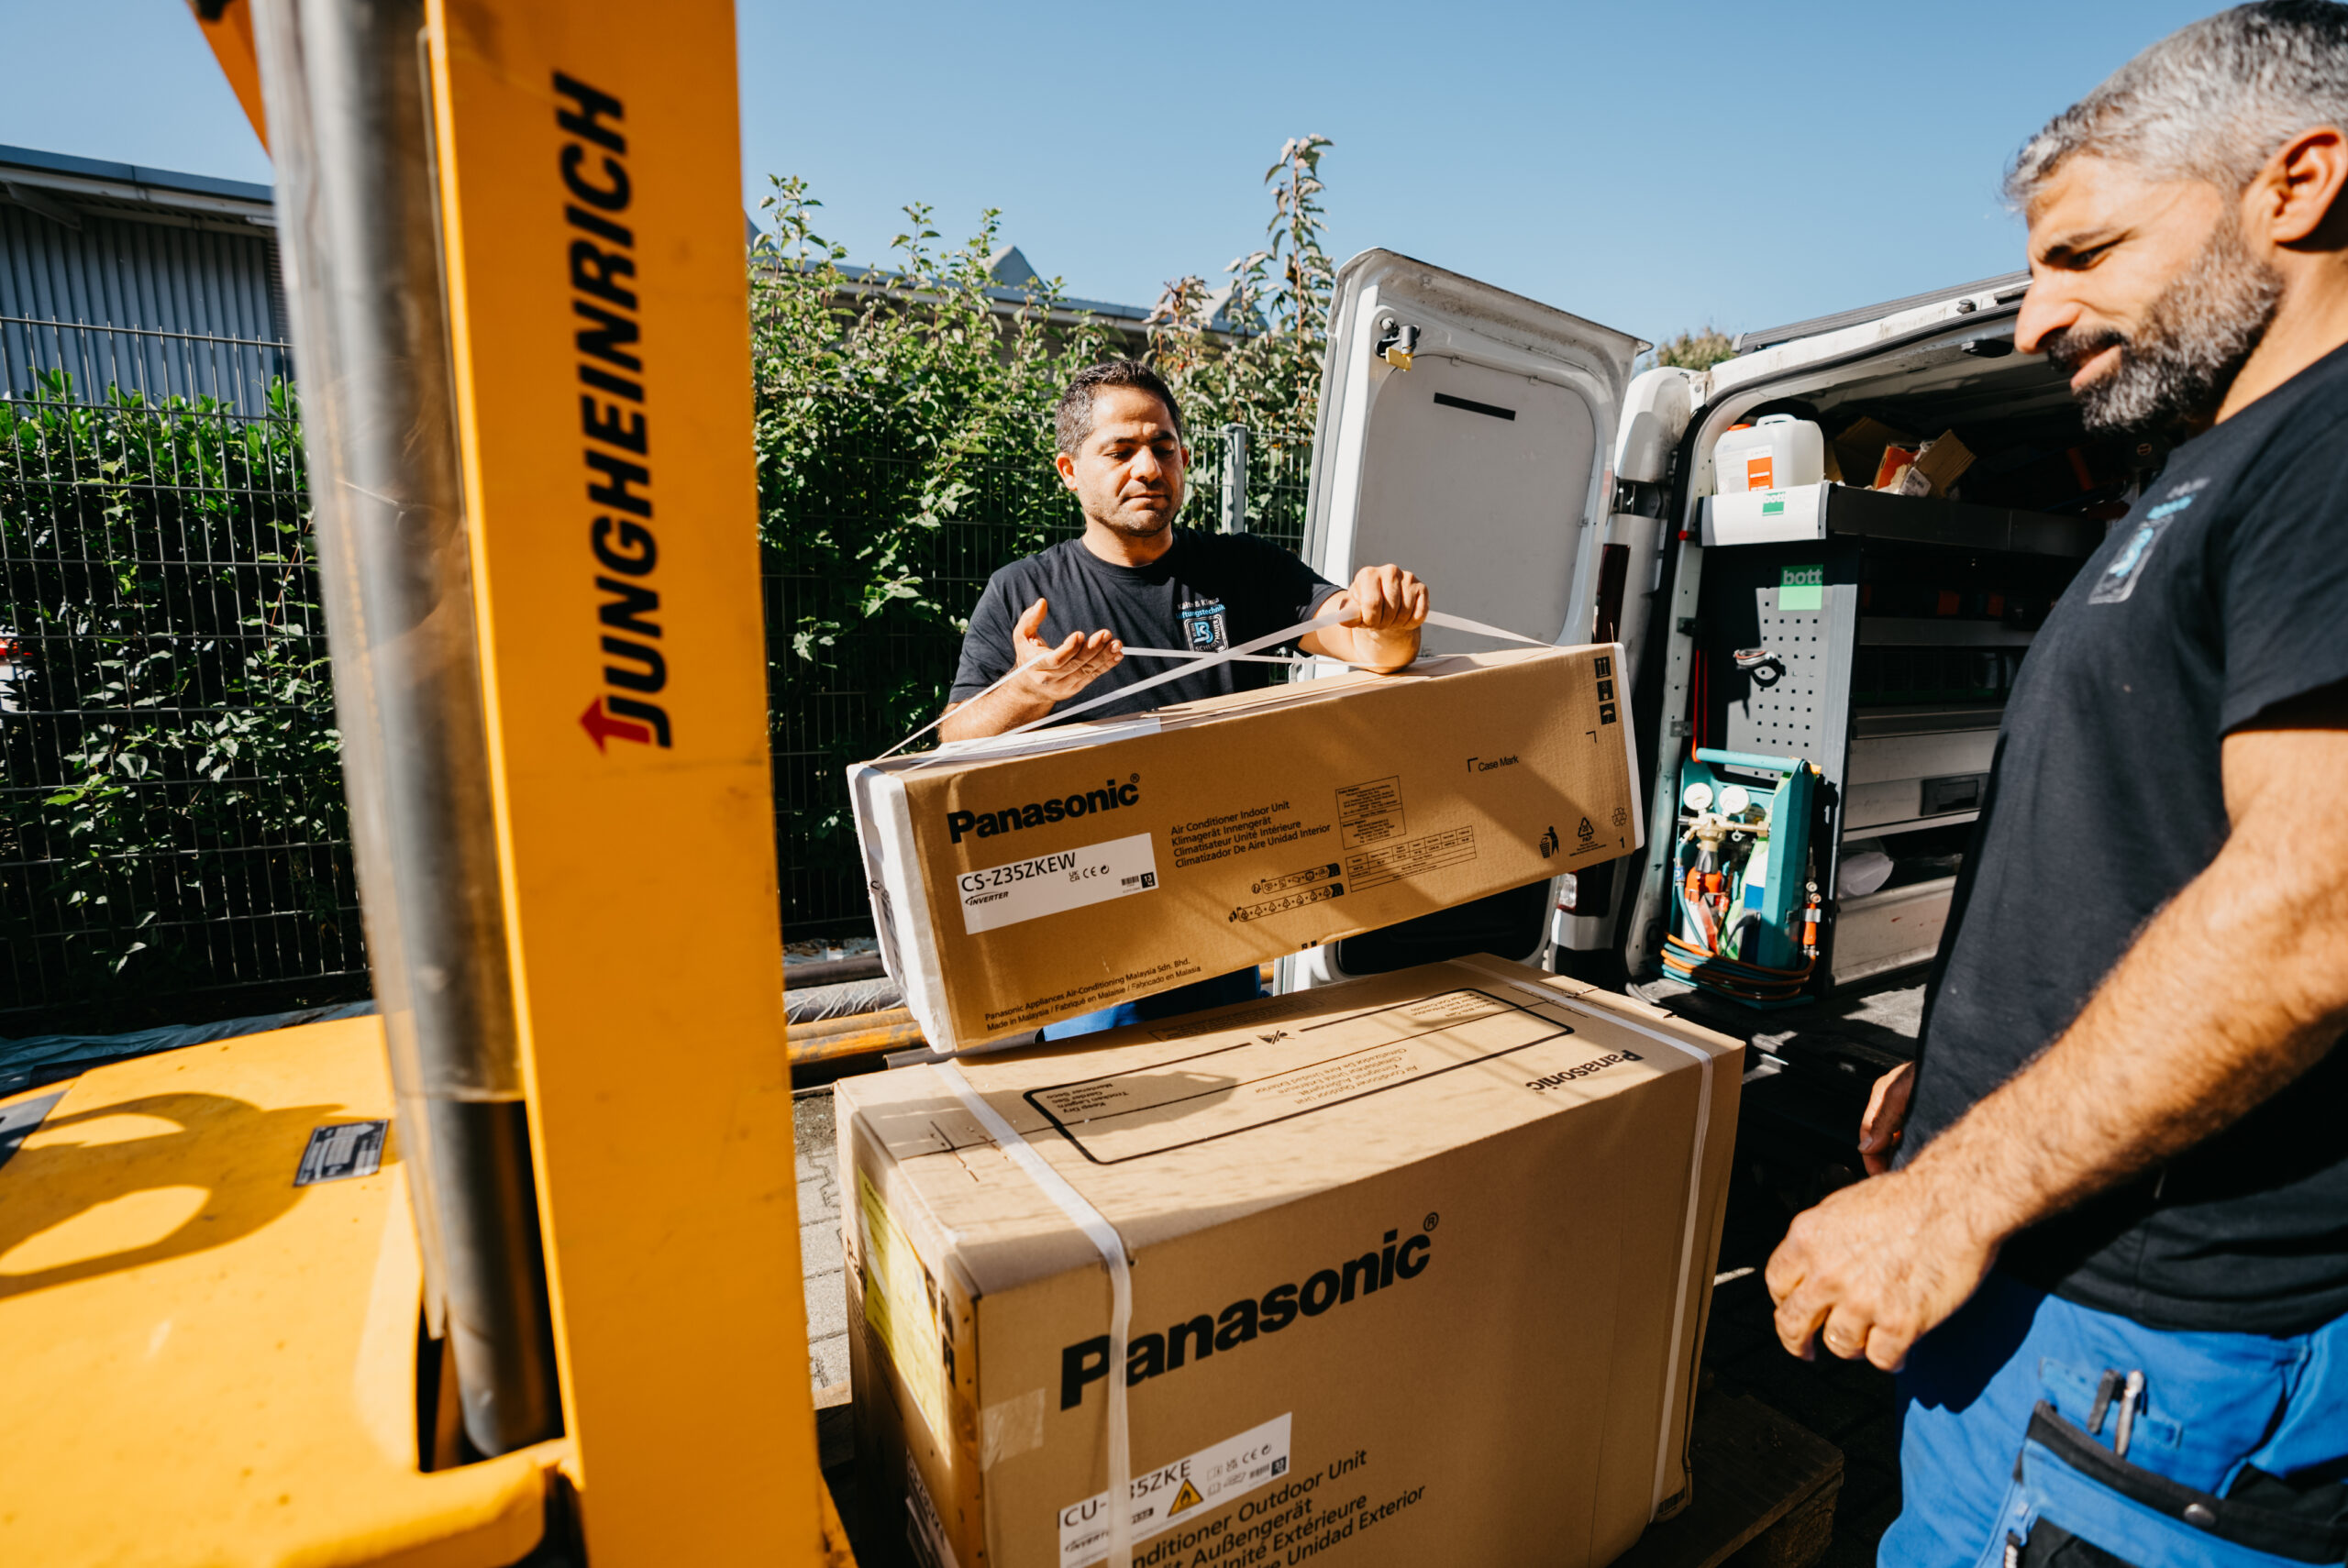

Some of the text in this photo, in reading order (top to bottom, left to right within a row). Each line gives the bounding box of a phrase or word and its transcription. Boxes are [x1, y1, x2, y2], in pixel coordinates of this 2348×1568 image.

[552, 70, 672, 749] JUNGHEINRICH
[1764, 491, 1787, 503] bott
[1783, 569, 1822, 585] bott
[1478, 755, 1519, 772] Case Mark
[947, 778, 1140, 845] Panasonic
[1170, 800, 1290, 835] Air Conditioner Indoor Unit
[1171, 816, 1271, 846] Klimagerät Innengerät
[1173, 821, 1301, 857] Climatisateur Unité Intérieure
[1175, 848, 1232, 868] Climatizador
[1233, 845, 1246, 855] De
[1247, 840, 1266, 851] Aire
[1267, 831, 1298, 845] Unidad
[1299, 823, 1331, 838] Interior
[1619, 836, 1625, 848] 1
[961, 852, 1076, 892] CS-Z35ZKEW
[966, 891, 1009, 906] INVERTER
[984, 957, 1191, 1021] Panasonic Appliances Air-Conditioning Malaysia Sdn. Bhd.
[986, 1020, 1008, 1032] Made
[1010, 1016, 1017, 1025] in
[1017, 1008, 1049, 1021] Malaysia
[1055, 997, 1086, 1012] Fabriqué
[1087, 995, 1096, 1003] en
[1097, 986, 1126, 999] Malaisie
[1131, 975, 1165, 989] Fabricado
[1165, 973, 1175, 981] en
[1175, 966, 1202, 978] Malasia
[1525, 1049, 1645, 1090] Panasonic
[1060, 1228, 1431, 1411] Panasonic
[1064, 1459, 1191, 1528] CU-5ZKE
[1131, 1515, 1232, 1568] nditioner
[1238, 1472, 1324, 1522] Outdoor
[1329, 1450, 1367, 1480] Unit
[1192, 1497, 1312, 1568] Außengerät
[1273, 1495, 1367, 1552] Extérieure
[1287, 1485, 1425, 1566] Unidad Exterior
